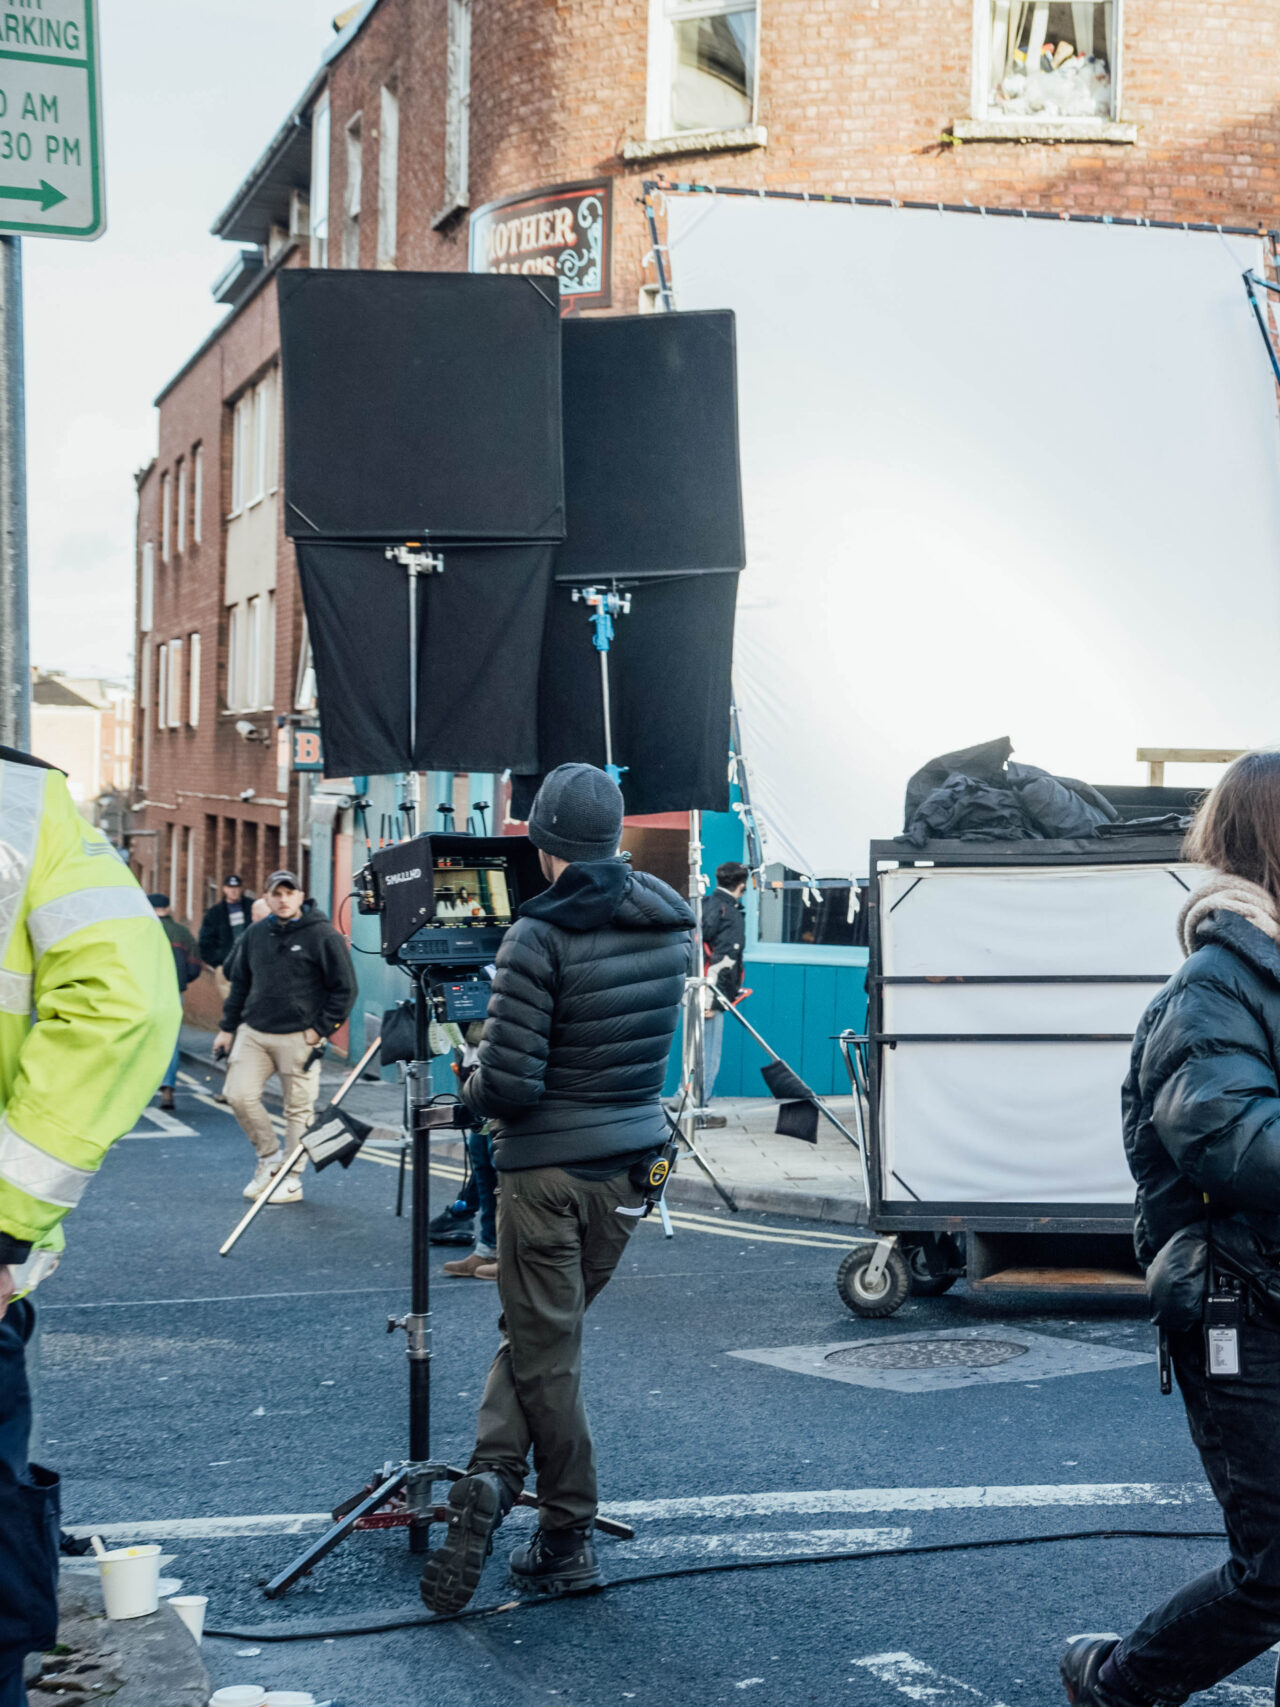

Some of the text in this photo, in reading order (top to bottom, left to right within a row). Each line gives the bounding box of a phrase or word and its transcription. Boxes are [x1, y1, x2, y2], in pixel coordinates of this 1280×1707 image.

[0, 13, 80, 51] RKING
[21, 92, 59, 124] AM
[46, 135, 80, 167] PM
[294, 731, 324, 764] B
